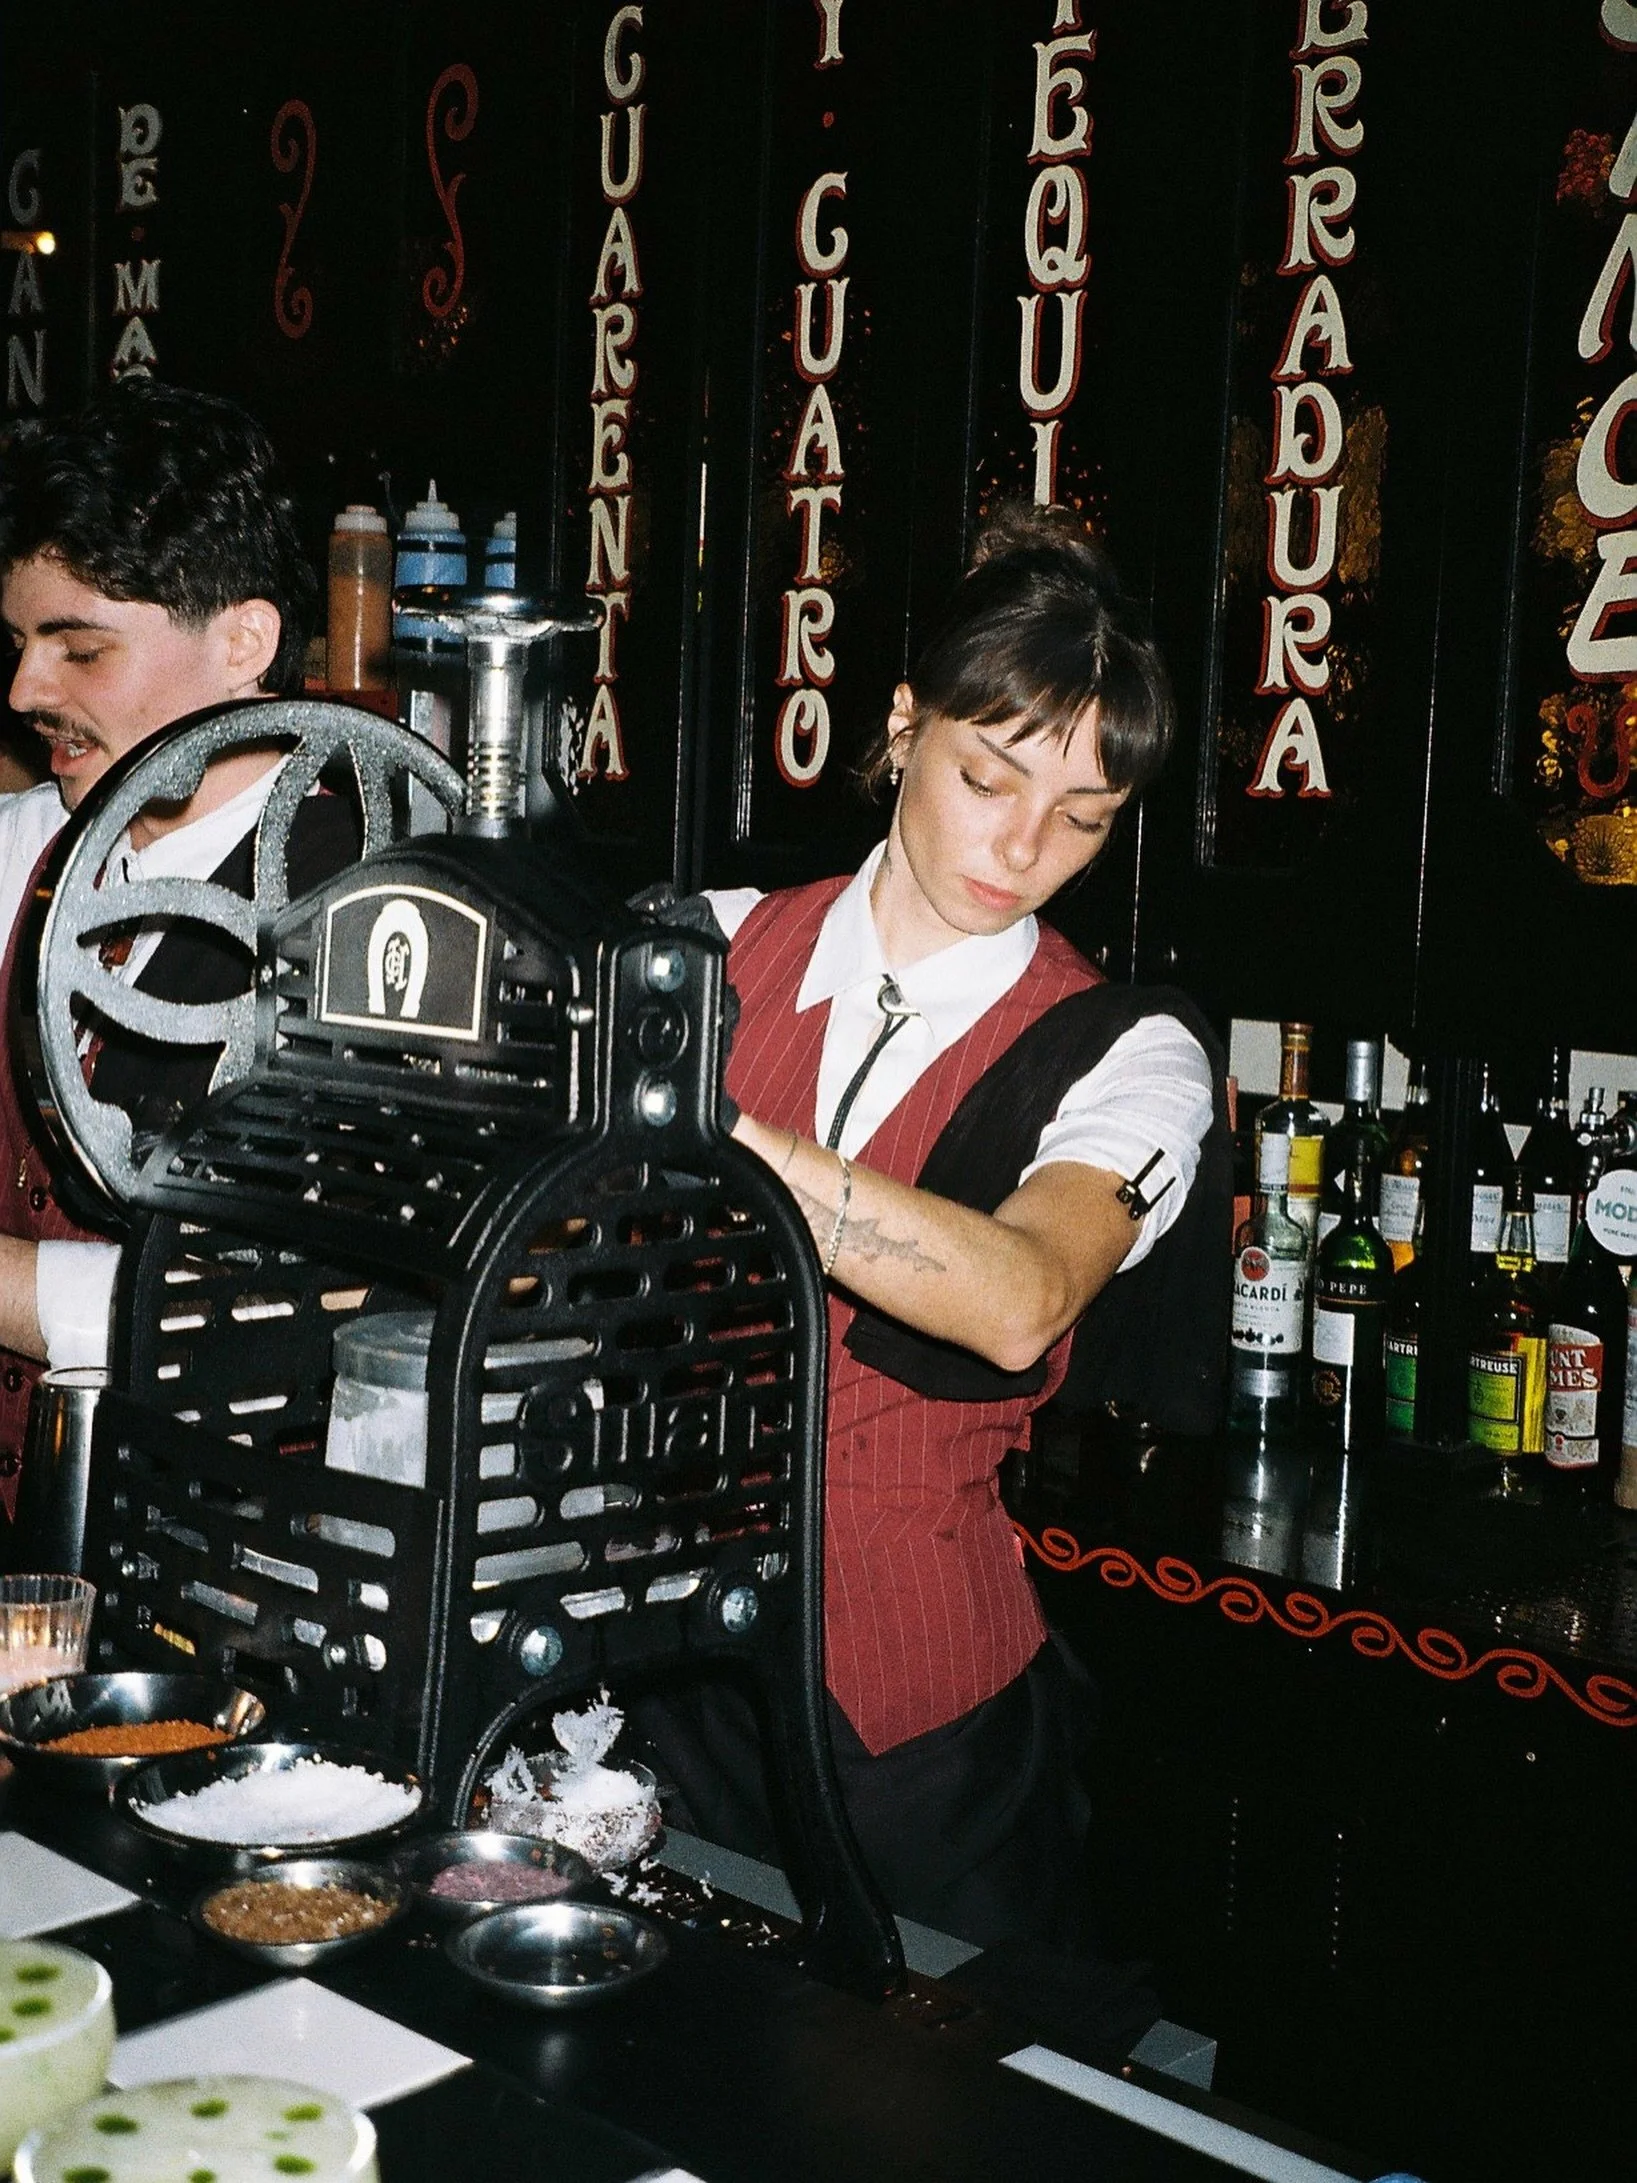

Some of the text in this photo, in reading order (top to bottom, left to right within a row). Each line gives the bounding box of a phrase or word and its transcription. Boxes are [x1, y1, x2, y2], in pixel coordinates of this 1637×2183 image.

[110, 103, 163, 380] DE MA
[579, 5, 646, 778] CUARENTA
[779, 171, 852, 782] CUATRO
[1017, 0, 1096, 506] EQUI
[1329, 1281, 1368, 1296] PEPE
